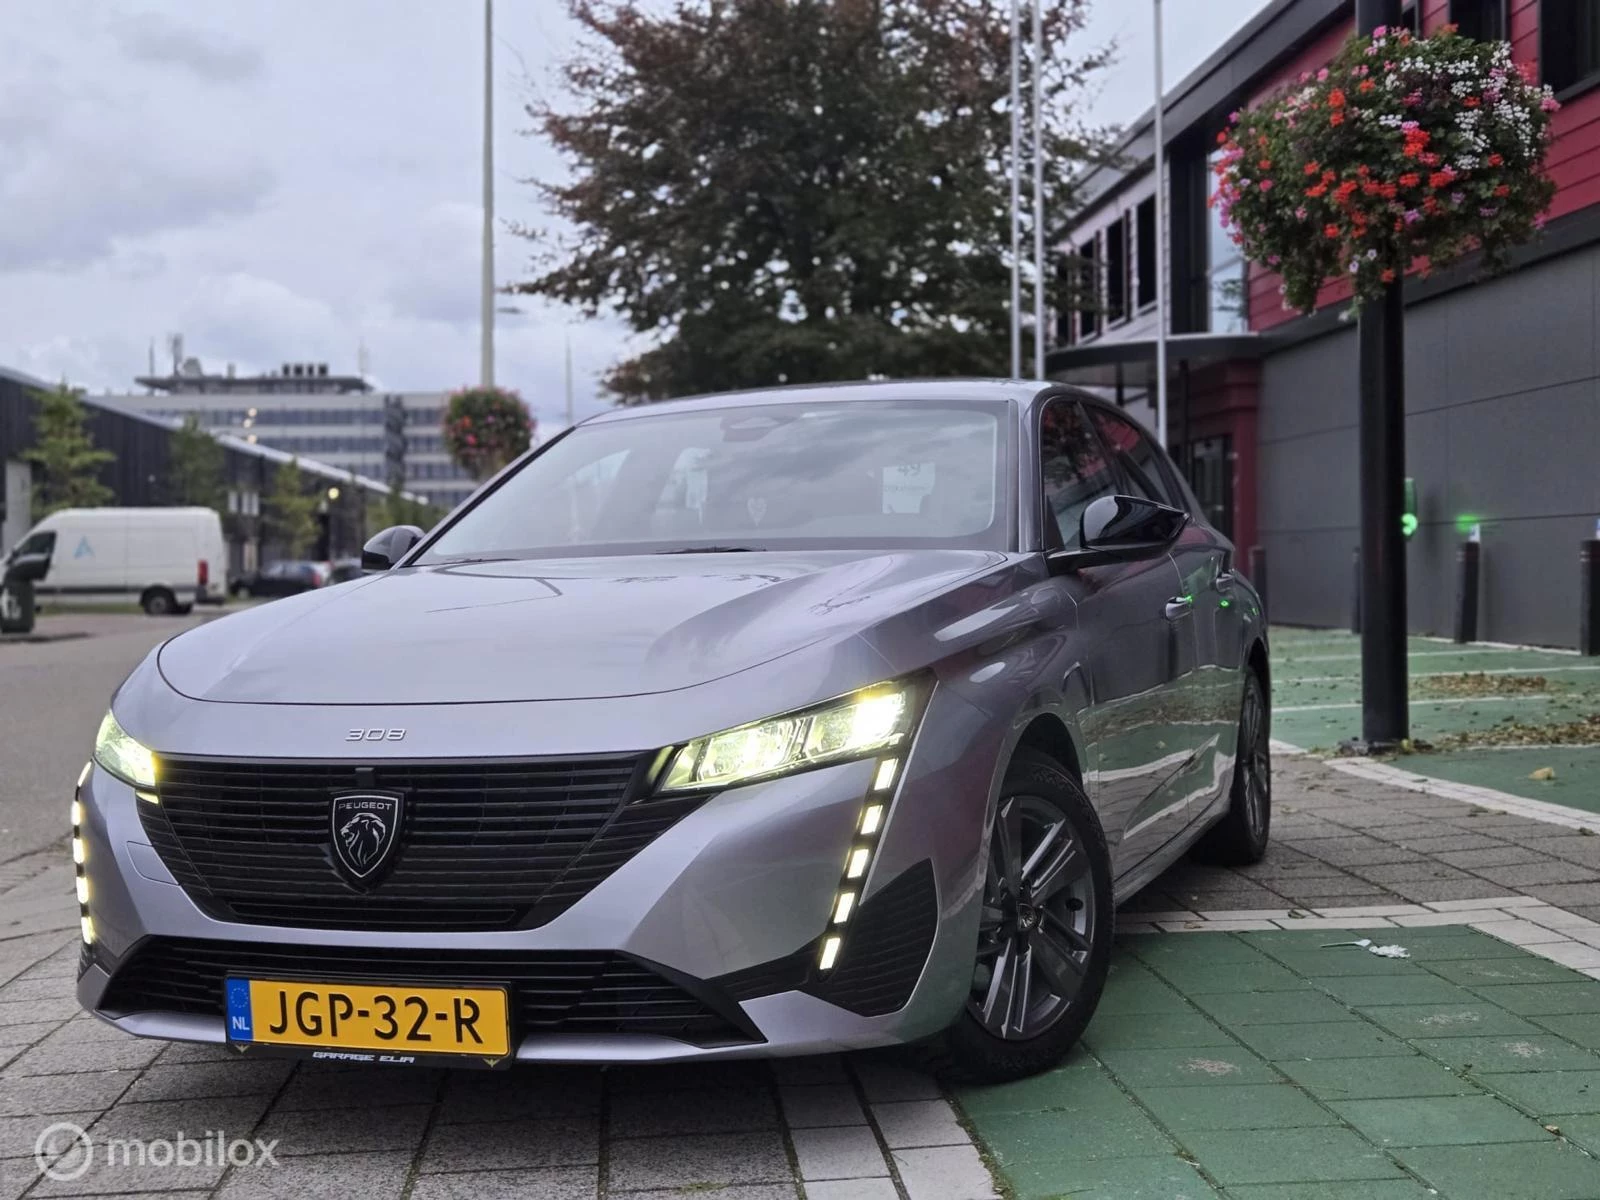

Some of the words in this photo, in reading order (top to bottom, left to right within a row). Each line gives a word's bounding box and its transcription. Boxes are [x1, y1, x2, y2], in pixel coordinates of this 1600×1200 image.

[345, 728, 406, 741] 308
[338, 801, 392, 810] PEUGEOT
[232, 1016, 250, 1030] NL
[269, 991, 483, 1044] JGP-32-R
[312, 1051, 375, 1061] GARAGE
